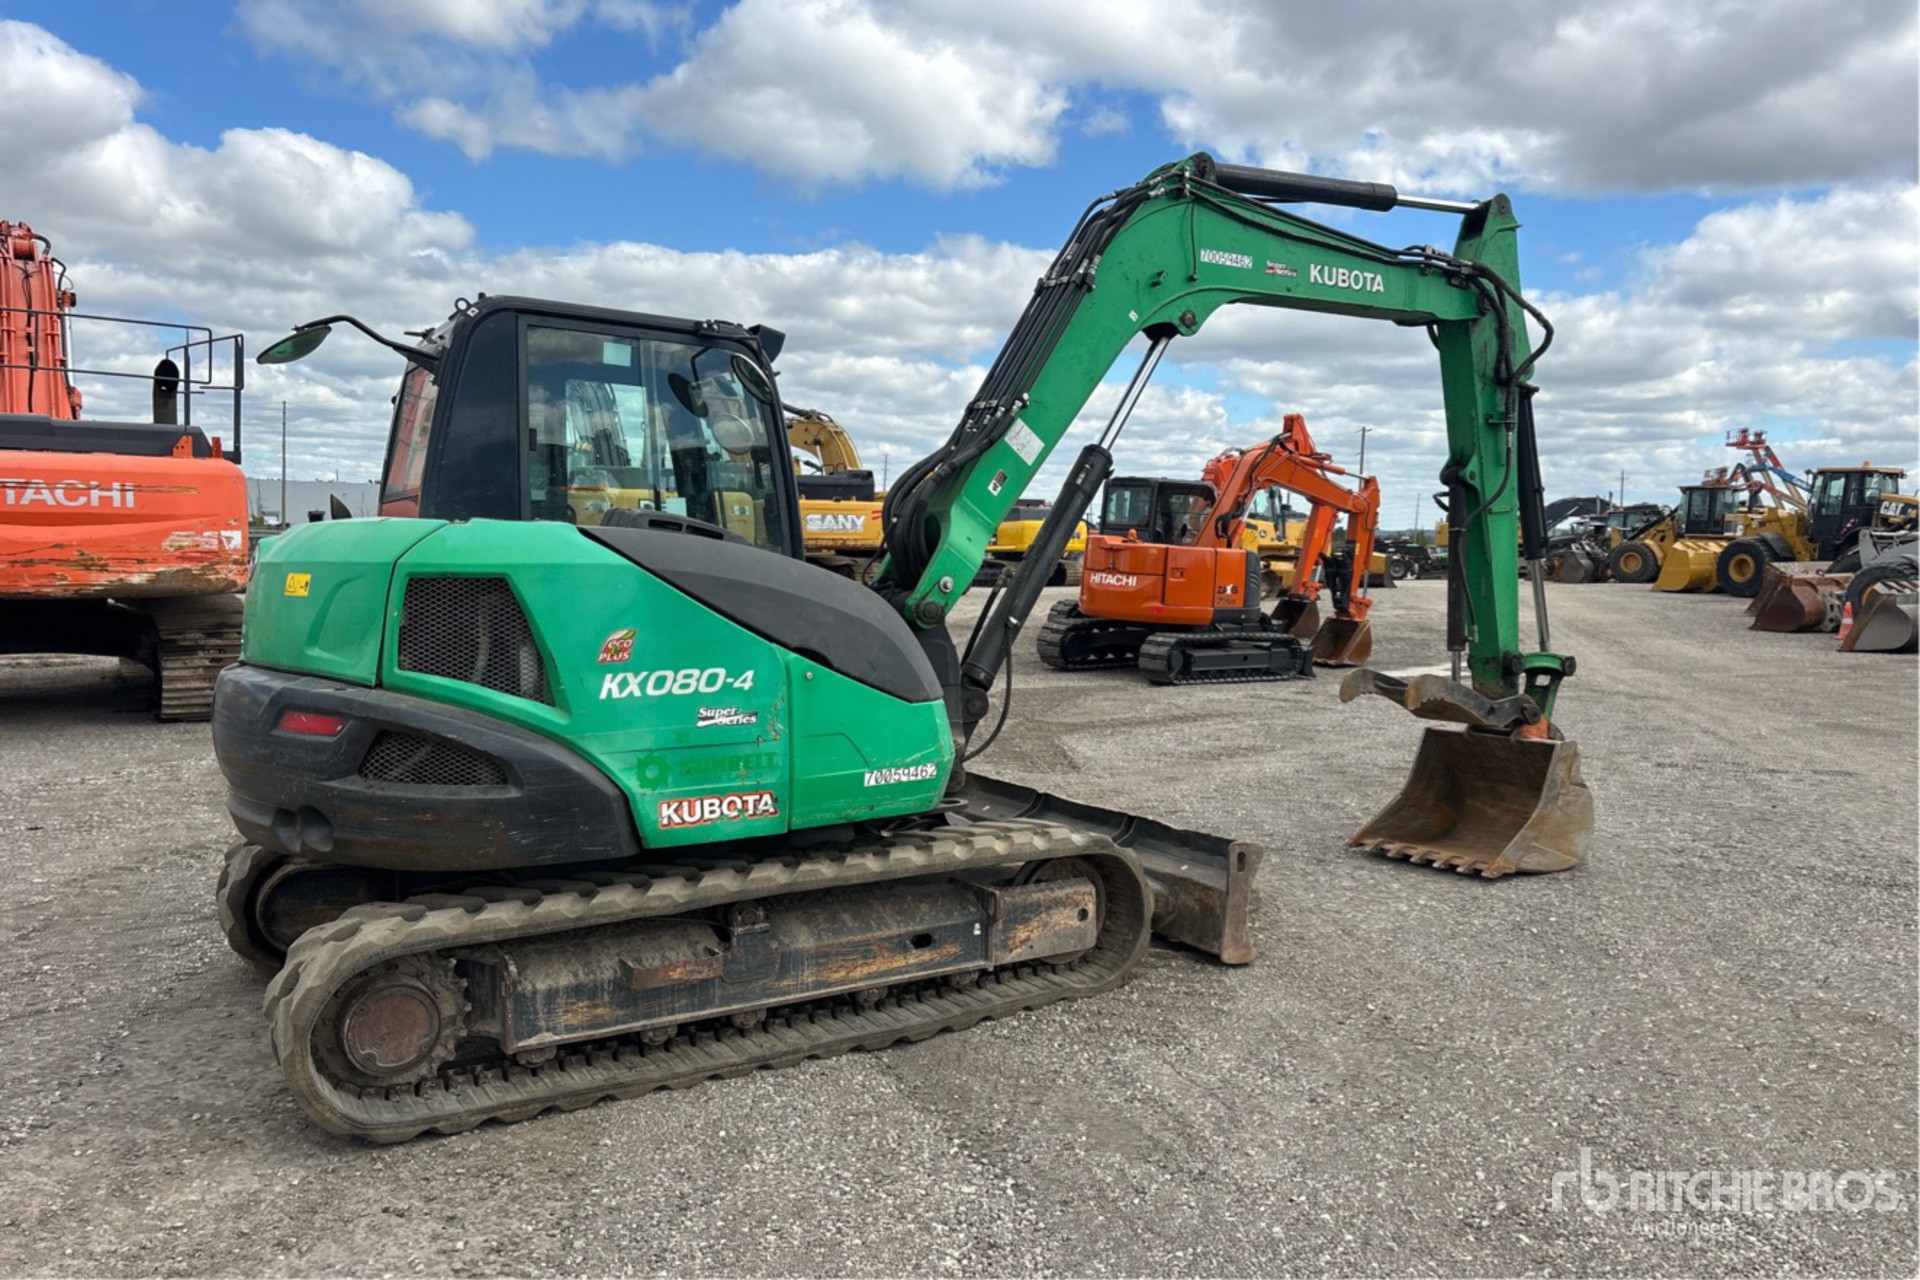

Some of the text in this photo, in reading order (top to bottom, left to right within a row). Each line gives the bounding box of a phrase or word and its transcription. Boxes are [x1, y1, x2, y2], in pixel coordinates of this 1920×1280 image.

[1201, 249, 1252, 268] 70059462
[1309, 263, 1385, 292] KUBOTA
[1880, 501, 1905, 516] CAT
[805, 513, 866, 533] SANY
[1090, 573, 1137, 587] HITACHI
[599, 651, 630, 662] PLUS
[599, 667, 755, 699] KX080-4
[698, 707, 738, 720] Super
[865, 764, 937, 785] 70059462
[661, 793, 775, 825] KUBOTA
